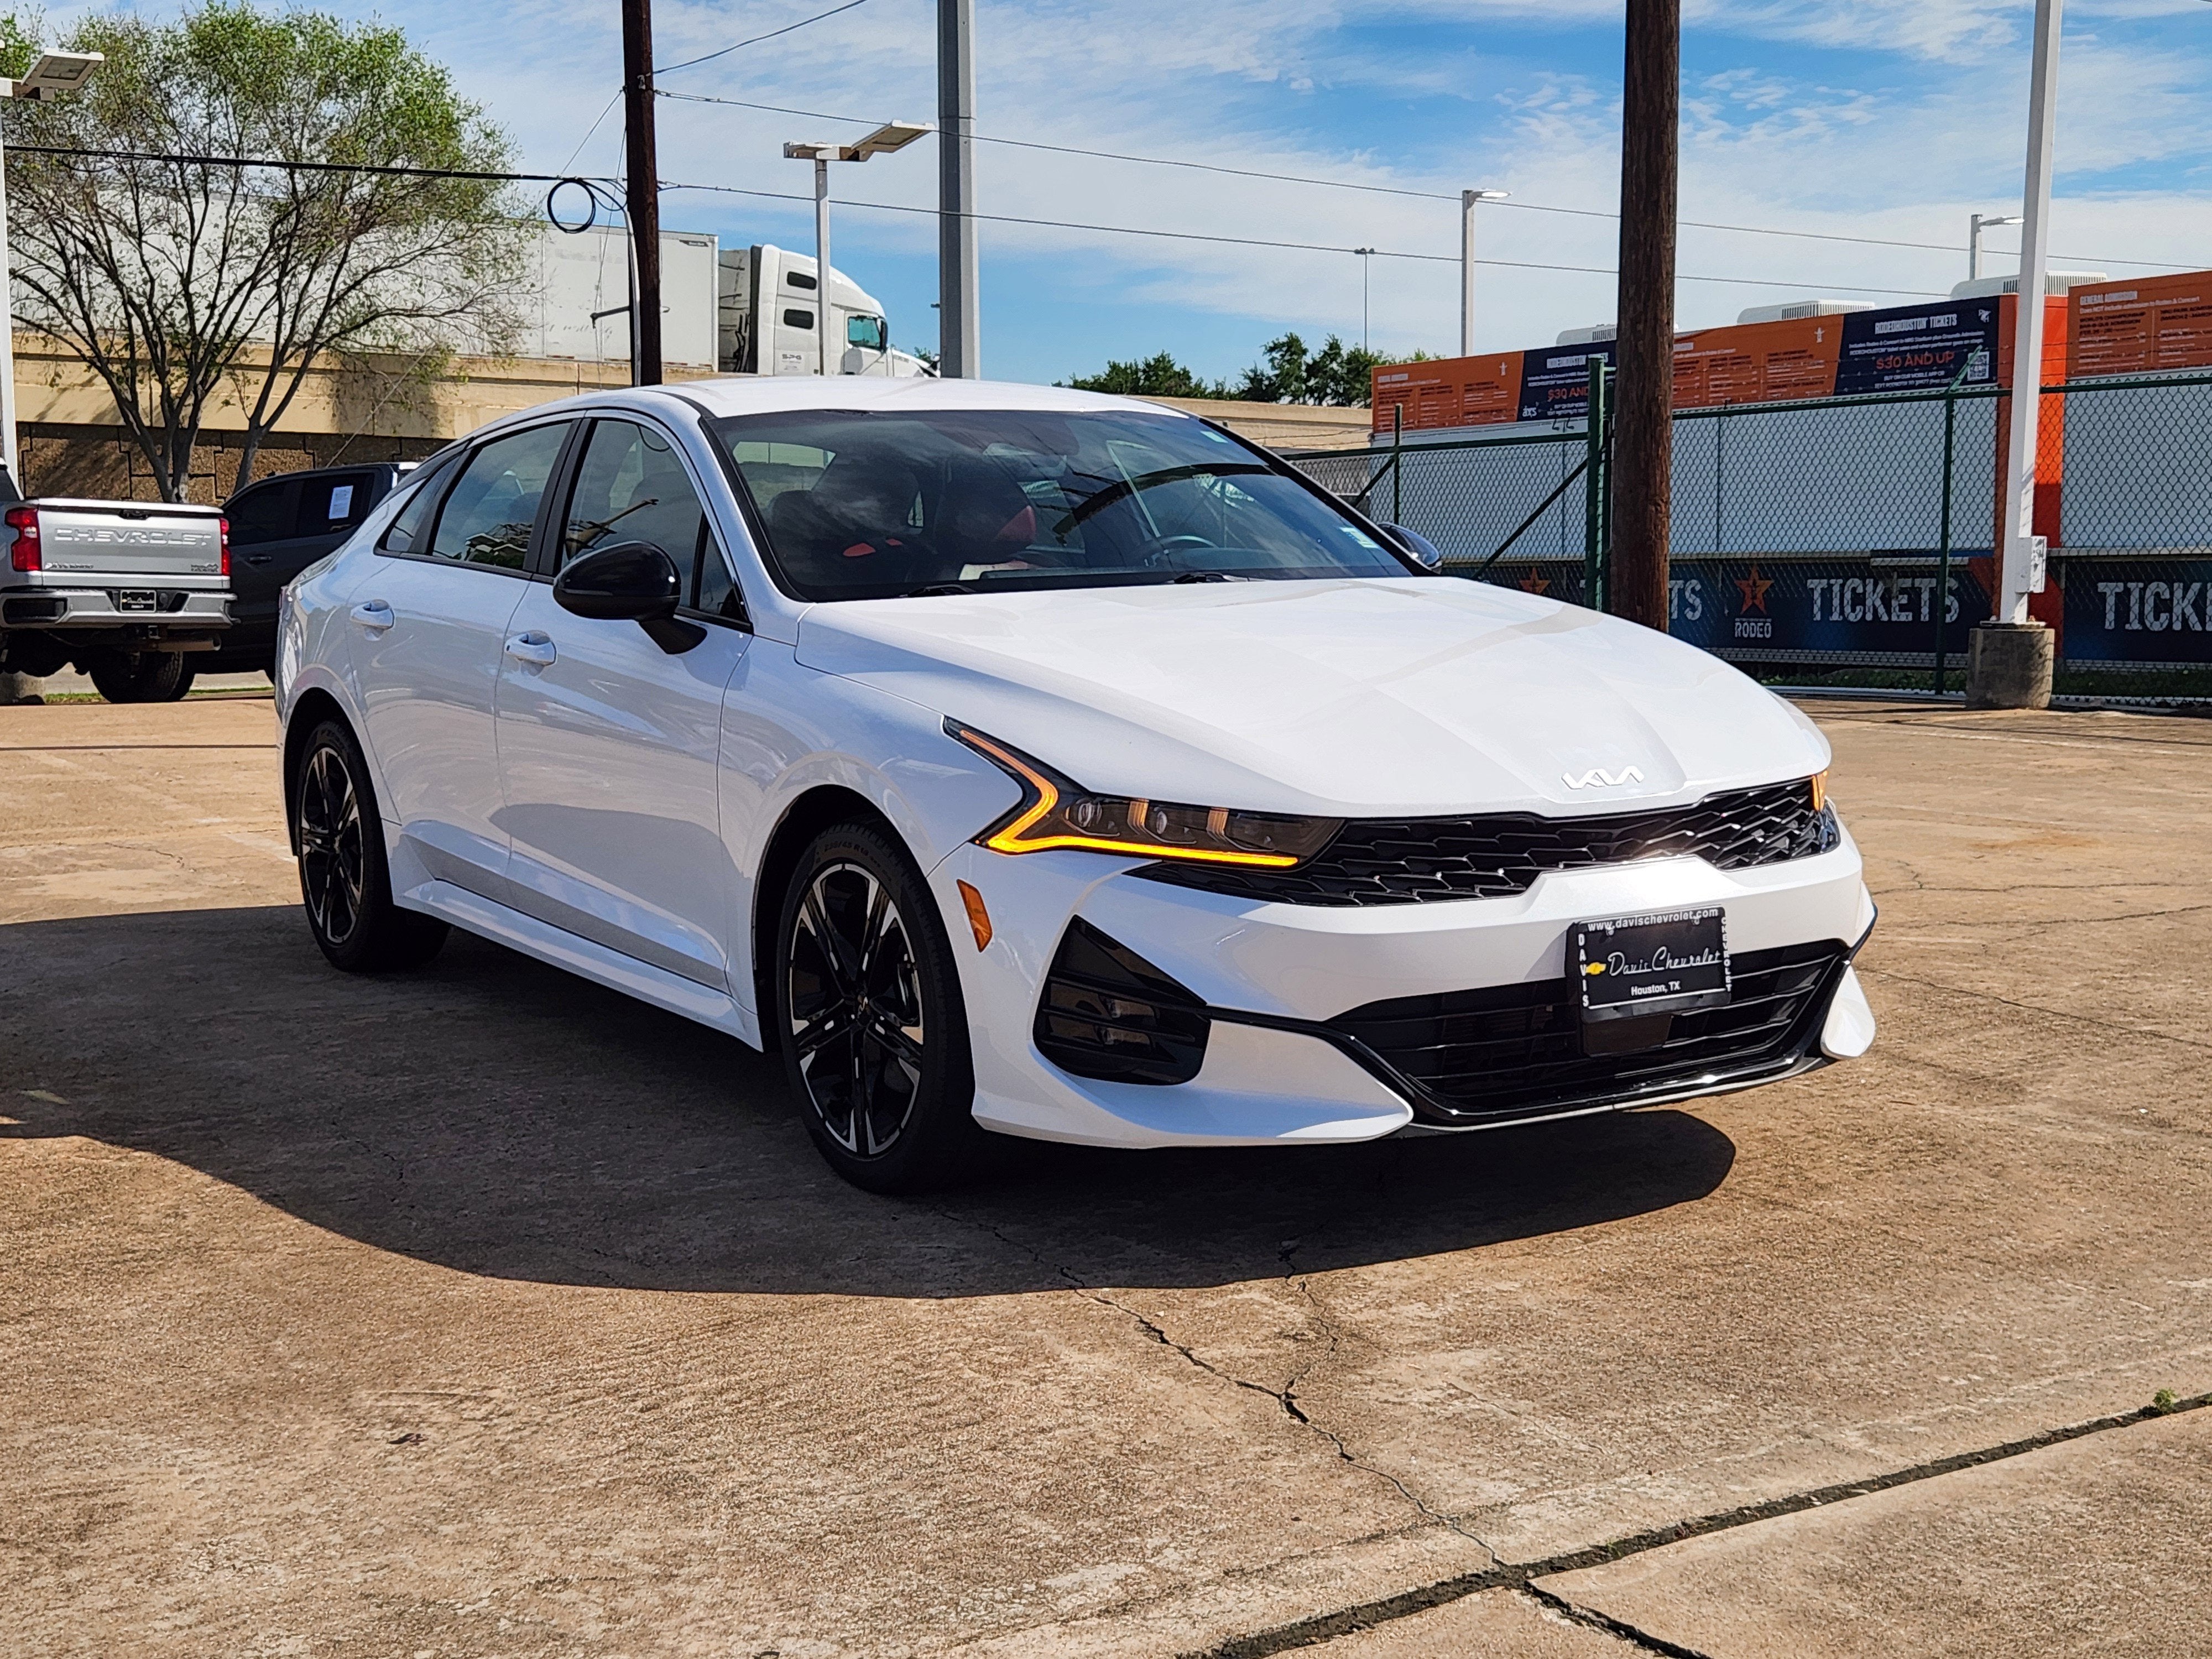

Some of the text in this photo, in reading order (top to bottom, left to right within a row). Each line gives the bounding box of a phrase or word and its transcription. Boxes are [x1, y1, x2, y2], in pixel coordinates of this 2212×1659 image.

[1876, 351, 1955, 370] $30 AND UP
[1548, 388, 1567, 399] $30
[55, 529, 212, 546] CHEVROLET
[1807, 578, 1959, 623] TICKETS
[2097, 582, 2212, 632] TICK
[1735, 622, 1772, 638] RODEO
[1588, 909, 1719, 932] www.davischevrolet.com
[1578, 933, 1589, 1008] DAVIS
[1607, 946, 1723, 977] Davis Chevrolet
[1631, 980, 1681, 996] Houston, TX
